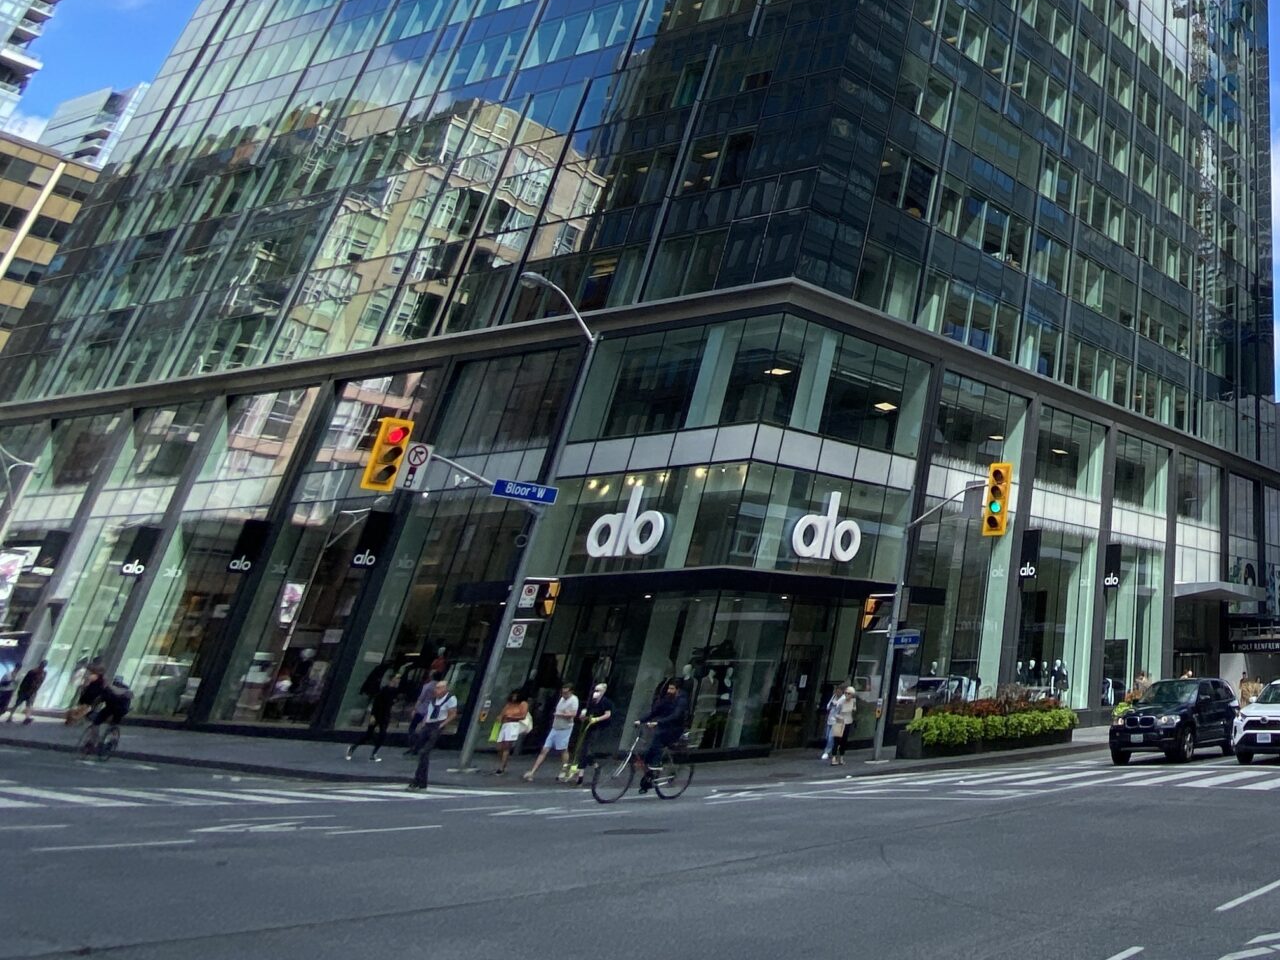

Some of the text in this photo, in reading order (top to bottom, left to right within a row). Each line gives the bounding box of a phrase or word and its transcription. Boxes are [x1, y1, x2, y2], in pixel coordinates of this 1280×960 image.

[505, 482, 531, 496] Bloor
[537, 487, 547, 499] W
[586, 485, 664, 557] alo
[792, 491, 861, 562] alo
[229, 554, 251, 571] alo
[353, 549, 376, 566] alo
[122, 559, 145, 575] alo
[1020, 562, 1036, 576] alo
[1104, 572, 1119, 585] alo
